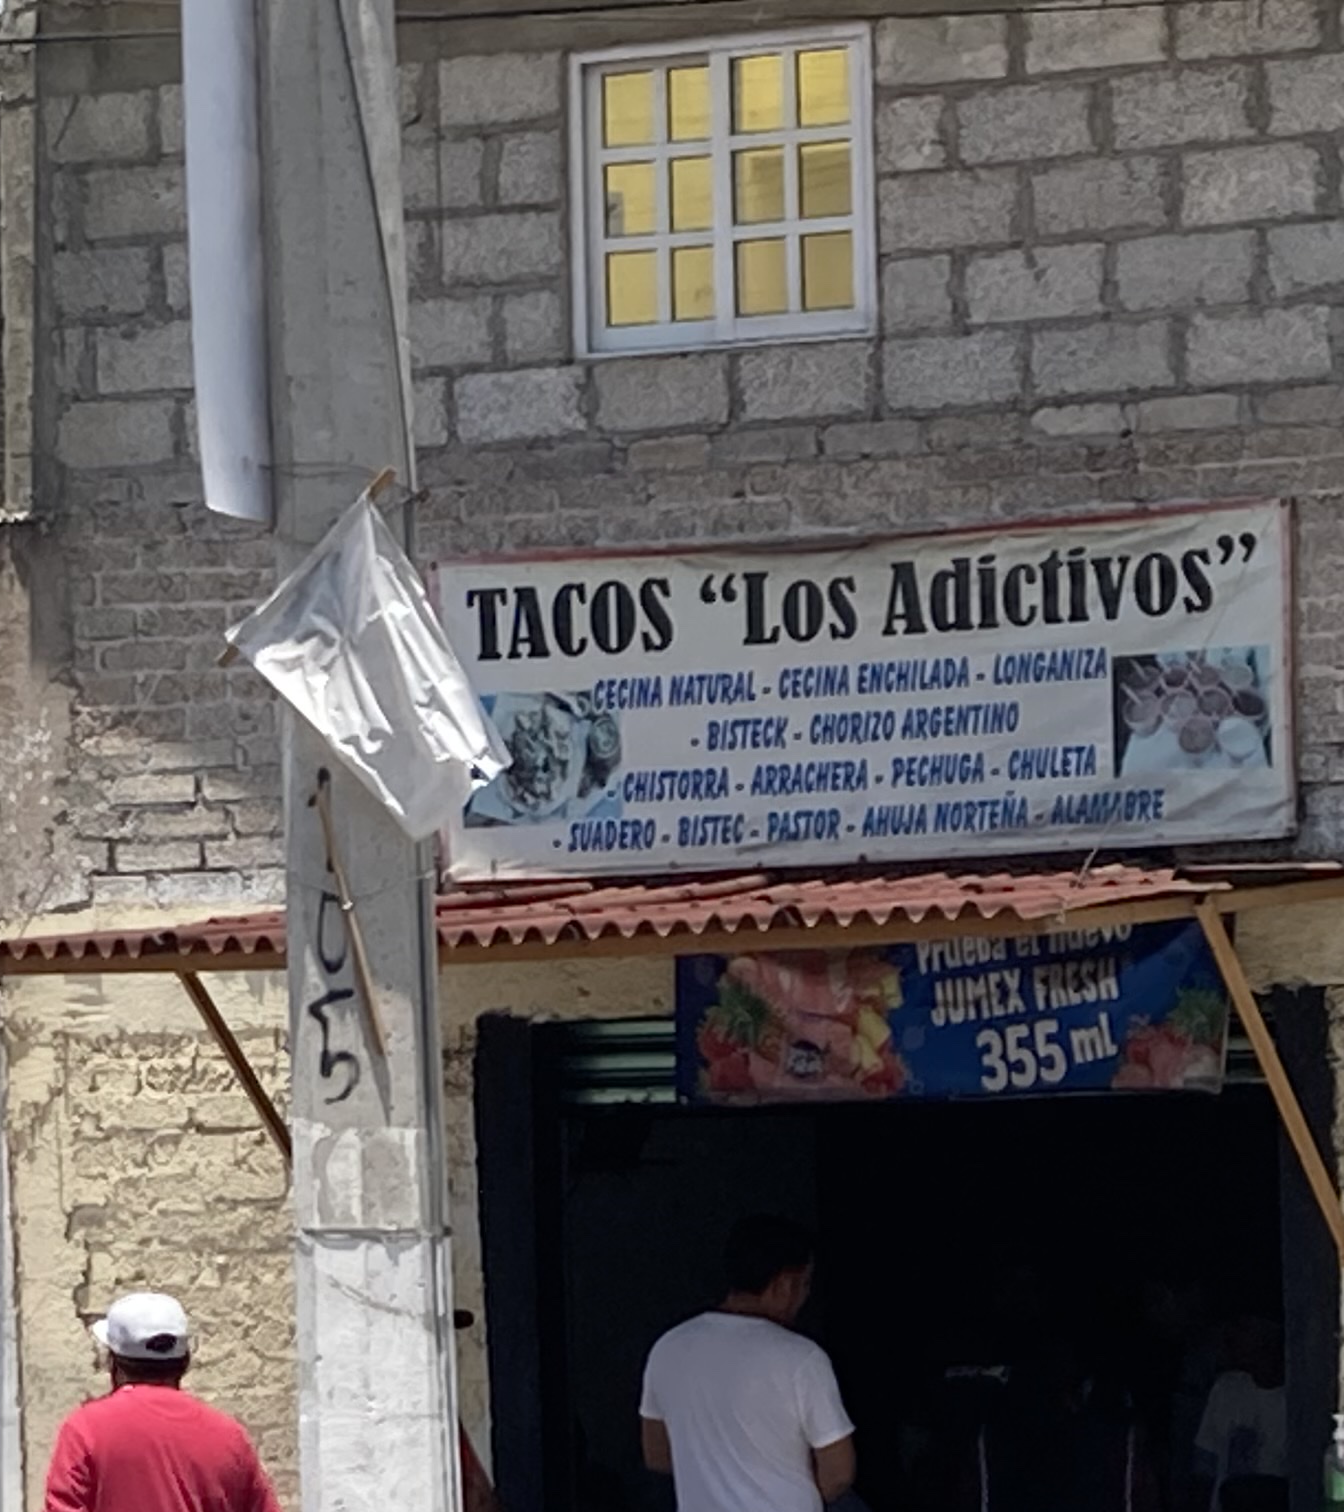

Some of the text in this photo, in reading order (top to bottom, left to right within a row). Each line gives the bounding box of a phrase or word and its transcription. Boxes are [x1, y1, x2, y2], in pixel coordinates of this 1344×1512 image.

[466, 577, 674, 661] TACOS
[593, 647, 1107, 712] CECINA NATURAL CECINA ENCHILADA LONGANIZA
[707, 701, 1020, 750] BISTECK CHORIZO ARGENTINO
[623, 745, 1096, 801] CHISTORRA ARRACHERA PECHUGA CHULETA
[568, 819, 655, 852] SUADERO
[678, 813, 745, 847] BISTEC
[767, 808, 841, 842] PASTOR
[861, 804, 928, 837] AHUJA
[933, 790, 1029, 831] NORTEÑA
[930, 957, 1120, 1027] JUMEX FRESH
[976, 1019, 1068, 1092] 355
